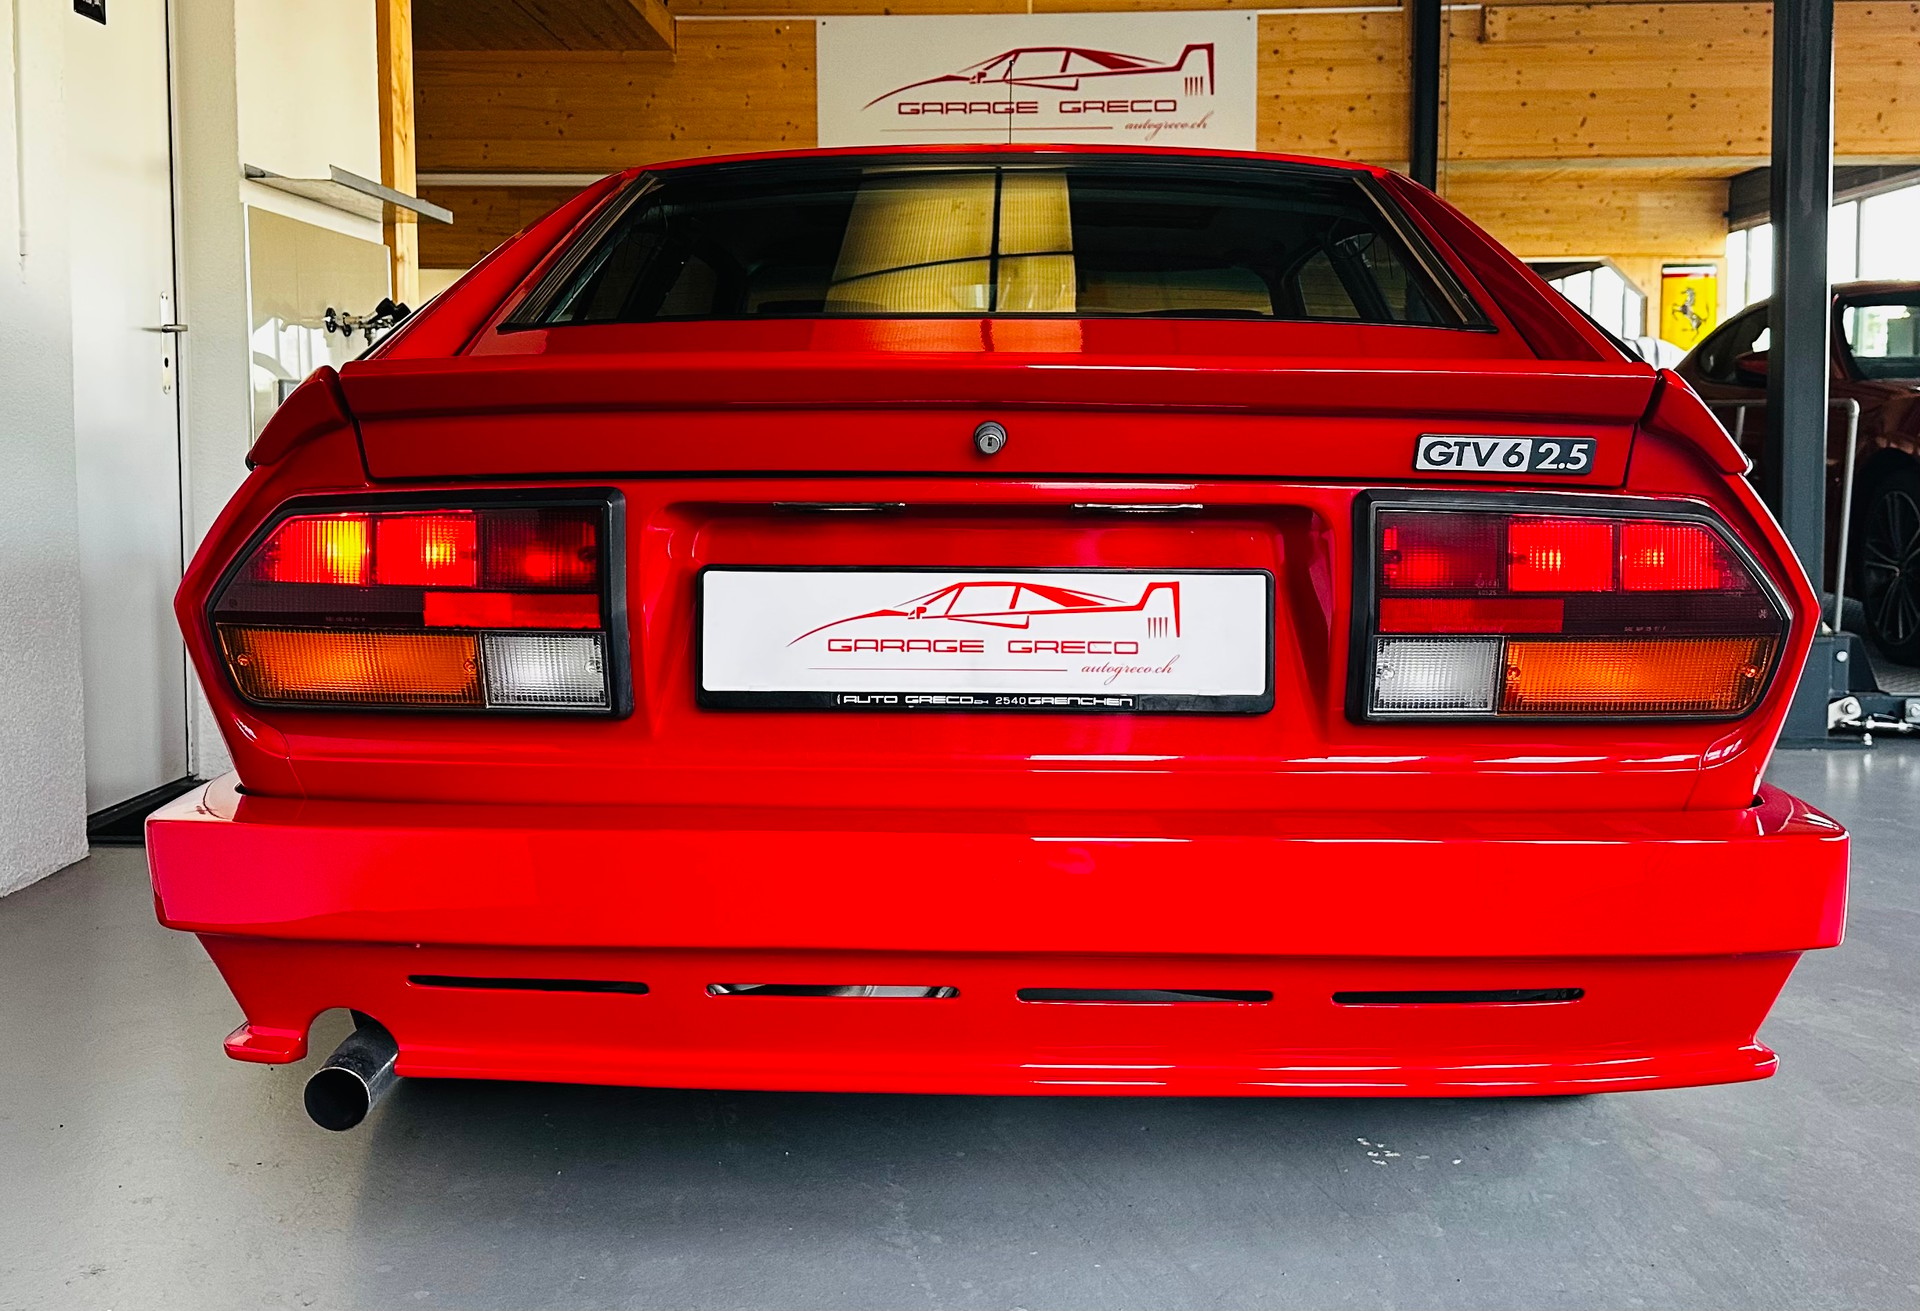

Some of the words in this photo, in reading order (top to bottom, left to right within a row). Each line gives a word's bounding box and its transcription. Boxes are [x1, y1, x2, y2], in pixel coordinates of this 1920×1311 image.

[898, 102, 1038, 115] GARAGE
[1059, 99, 1176, 113] GRECO
[1124, 110, 1213, 141] autogreco.ch
[1423, 441, 1500, 467] GTV
[1503, 443, 1524, 467] 6
[1536, 443, 1588, 470] 2.5
[828, 639, 984, 653] GARAGE
[1008, 640, 1139, 655] GRECO
[1081, 654, 1180, 686] autogreco.ch
[843, 695, 898, 704] AUTO
